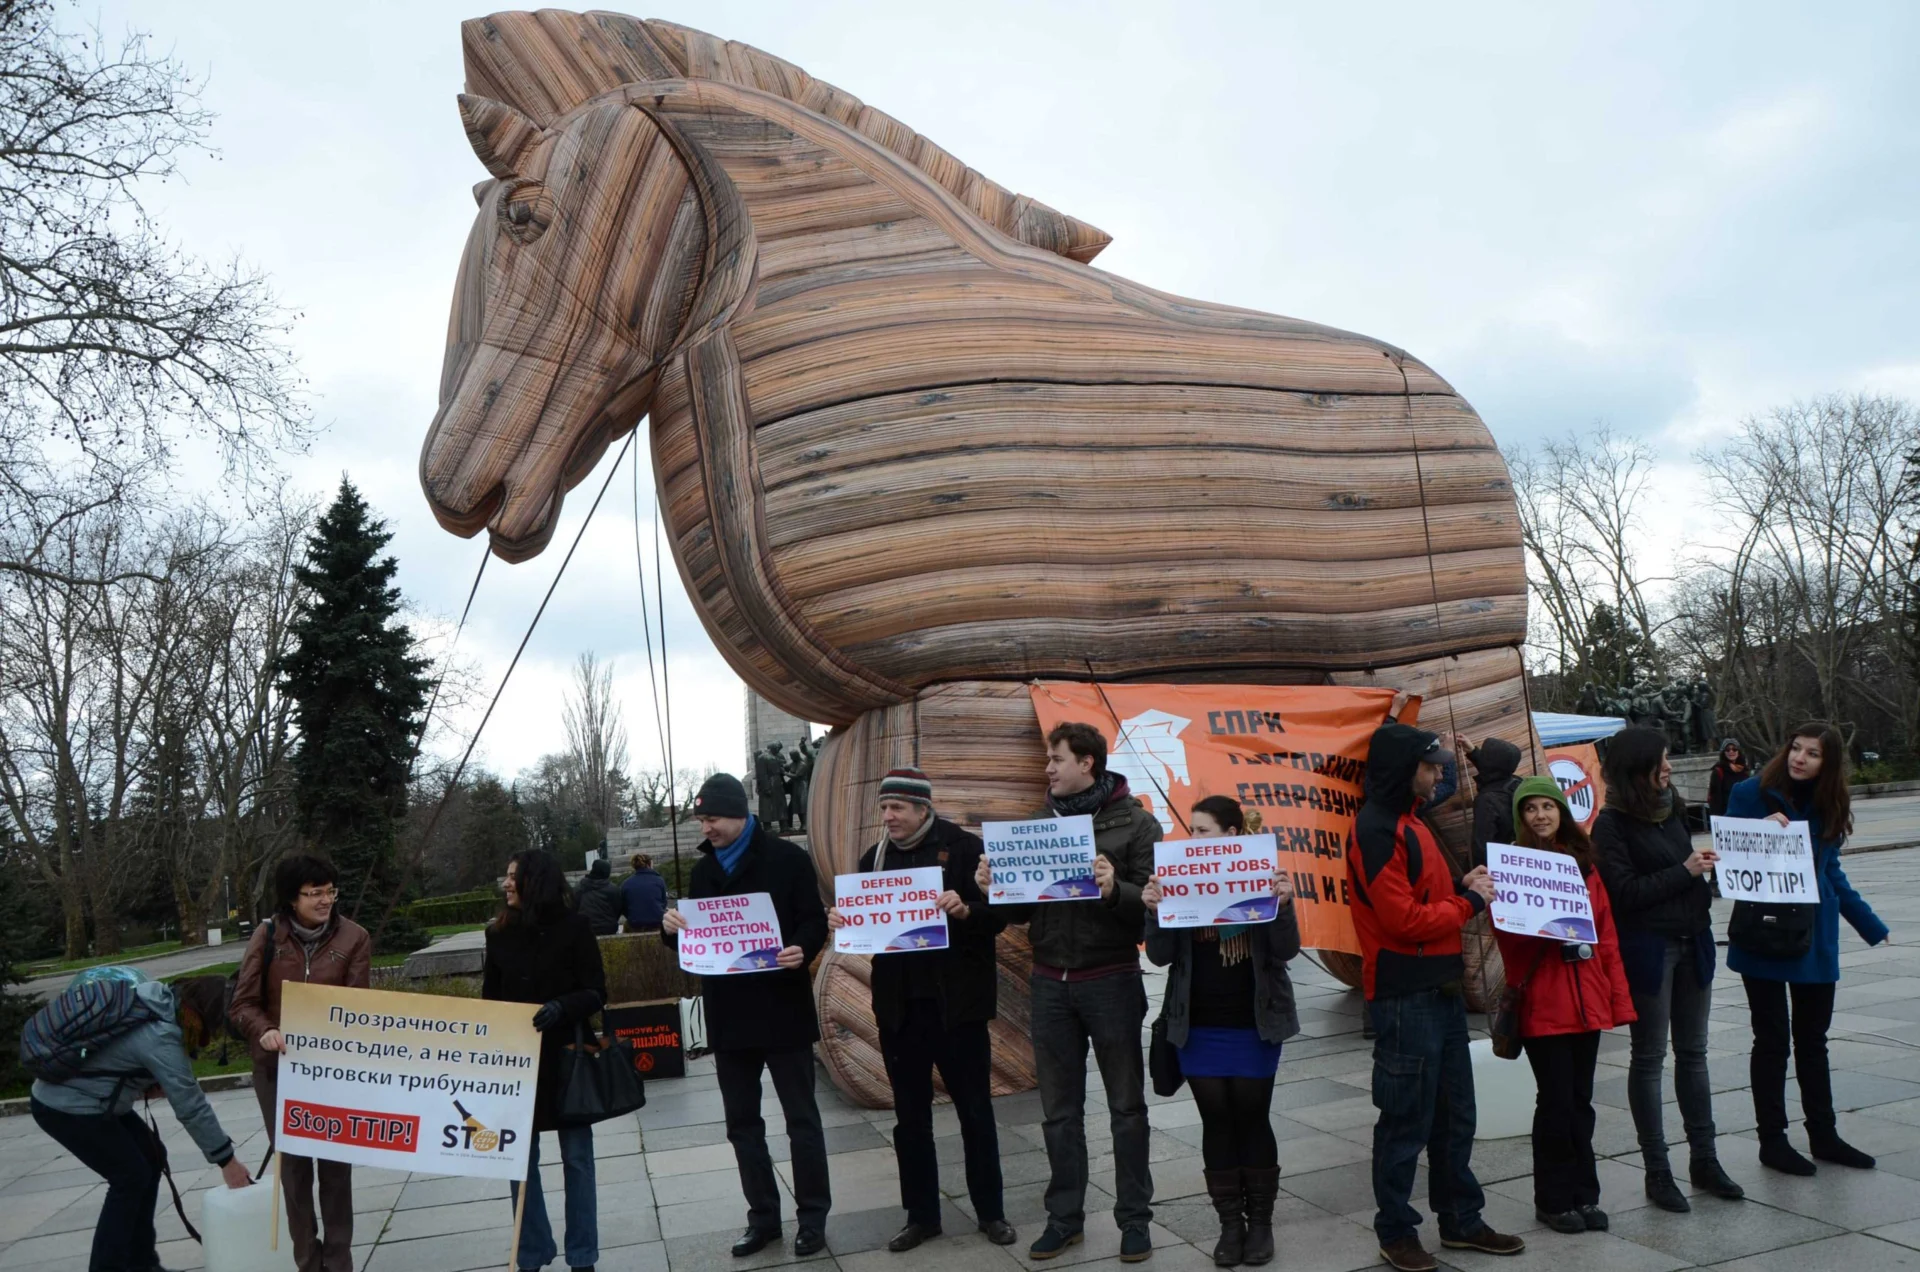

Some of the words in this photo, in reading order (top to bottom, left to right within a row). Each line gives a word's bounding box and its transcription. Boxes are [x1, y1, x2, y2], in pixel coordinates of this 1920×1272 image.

[1011, 823, 1058, 835] DEFEND
[988, 835, 1090, 852] SUSTAINABLE
[1185, 844, 1243, 857] DEFEND
[1157, 862, 1221, 877] DECENT
[1227, 858, 1275, 873] JOBS,
[1500, 853, 1552, 871] DEFEND
[1555, 862, 1579, 877] THE
[861, 876, 913, 889] DEFEND
[993, 871, 1017, 884] NO
[1021, 869, 1044, 882] TO
[1049, 867, 1094, 881] TTIP!
[1725, 868, 1762, 892] STOP
[1767, 871, 1806, 894] TTIP!
[1162, 884, 1189, 897] NO
[1194, 882, 1219, 895] TO
[1224, 878, 1274, 893] TTIP!
[697, 897, 750, 911] DEFEND
[838, 893, 894, 908] DECENT
[1495, 889, 1519, 904] NO
[1523, 893, 1545, 908] TO
[1549, 897, 1588, 915] TTIP!
[709, 910, 744, 923] DATA
[840, 914, 864, 927] NO
[869, 912, 892, 925] TO
[896, 908, 941, 923] TTIP!
[684, 921, 775, 939] PROTECTION,
[681, 943, 706, 955] NO
[711, 941, 734, 954] TO
[738, 937, 780, 952] TTIP!
[329, 1006, 470, 1034] Прозрачност
[475, 1023, 488, 1036] и
[614, 1026, 653, 1037] MACHINE
[284, 1033, 413, 1061] правосъдие,
[419, 1047, 431, 1060] а
[437, 1049, 462, 1063] не
[468, 1049, 531, 1068] тайни
[290, 1061, 392, 1085] търговски
[398, 1073, 521, 1097] трибунали!
[288, 1106, 342, 1141] Stop
[347, 1114, 413, 1144] TTIP!
[441, 1124, 517, 1152] STOP
